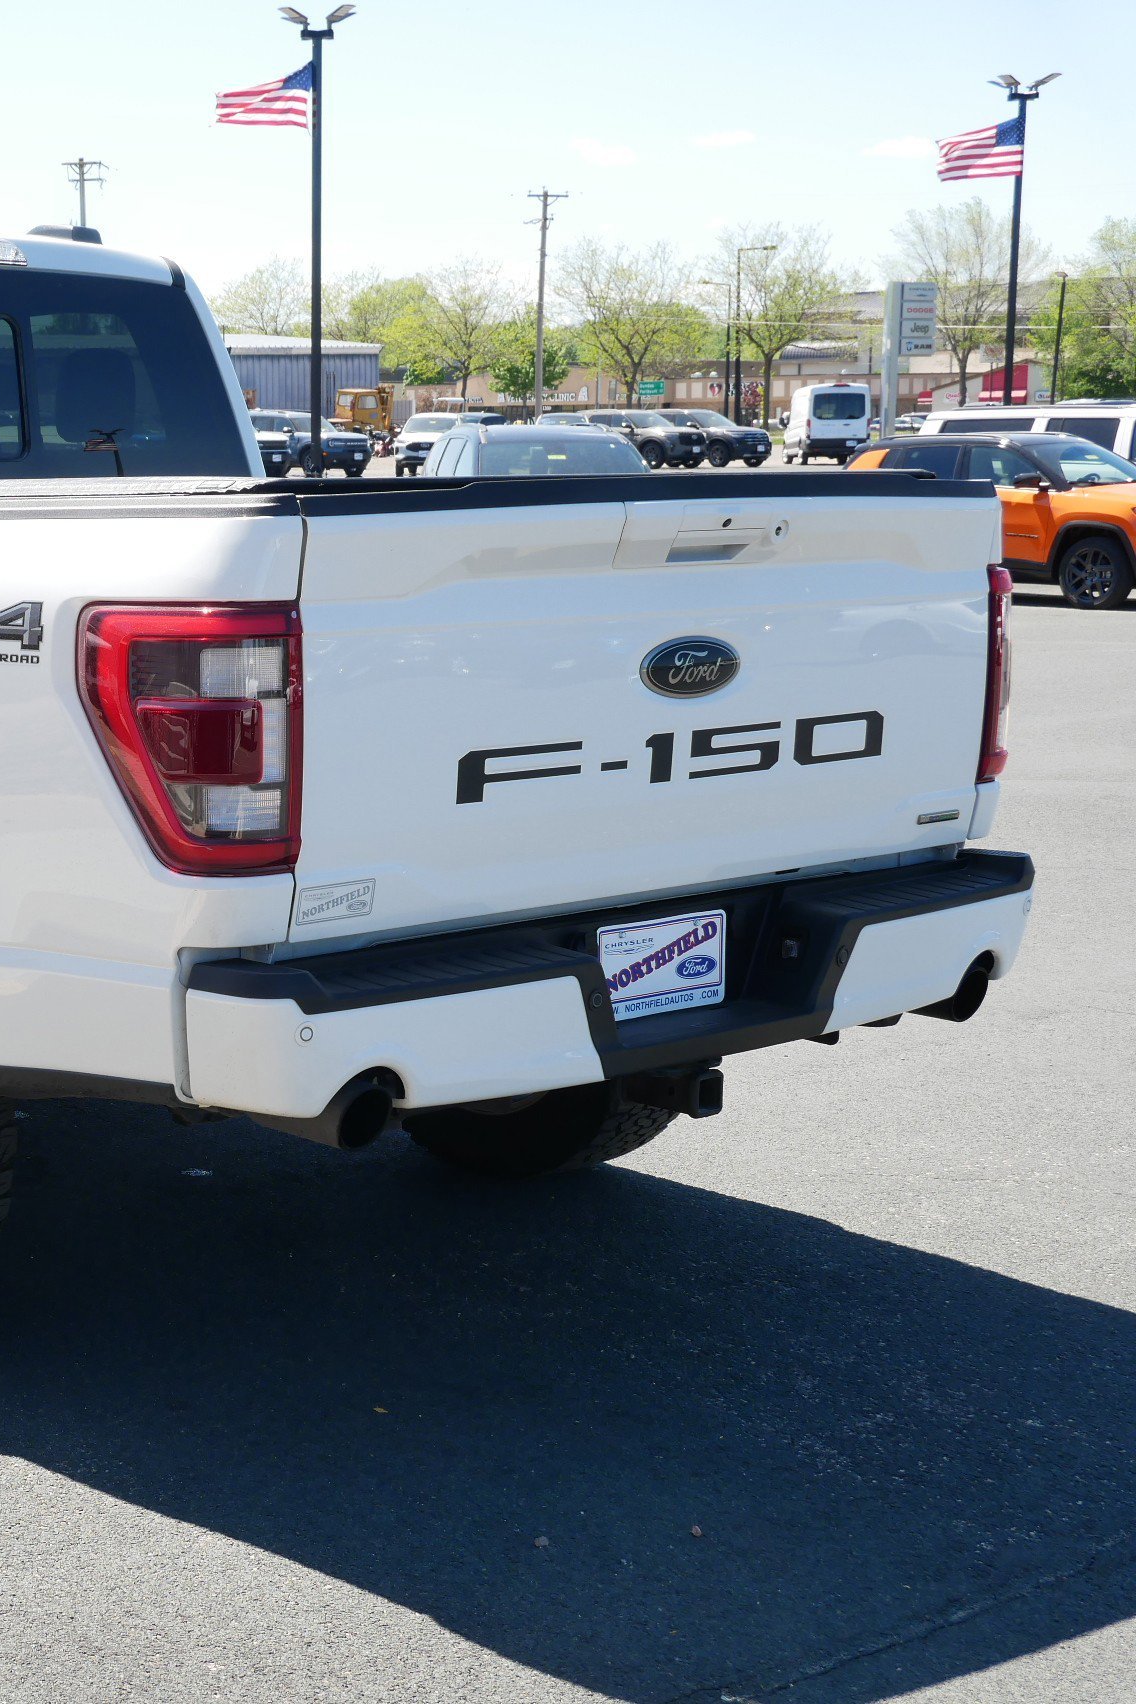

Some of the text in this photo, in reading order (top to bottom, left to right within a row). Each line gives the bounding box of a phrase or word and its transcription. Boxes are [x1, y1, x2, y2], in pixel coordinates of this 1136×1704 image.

[911, 323, 929, 335] Jeep
[549, 393, 576, 402] CLINIC
[0, 653, 40, 664] ROAD
[668, 649, 725, 685] Ford
[456, 710, 884, 804] F-150
[301, 885, 371, 920] NORTHFIELD
[605, 937, 654, 949] CHRYSLER
[606, 920, 718, 995] NORTHFIELD
[683, 959, 708, 975] Ford
[624, 993, 694, 1013] NORTHFIELDAUTOS
[699, 989, 719, 1000] .COM
